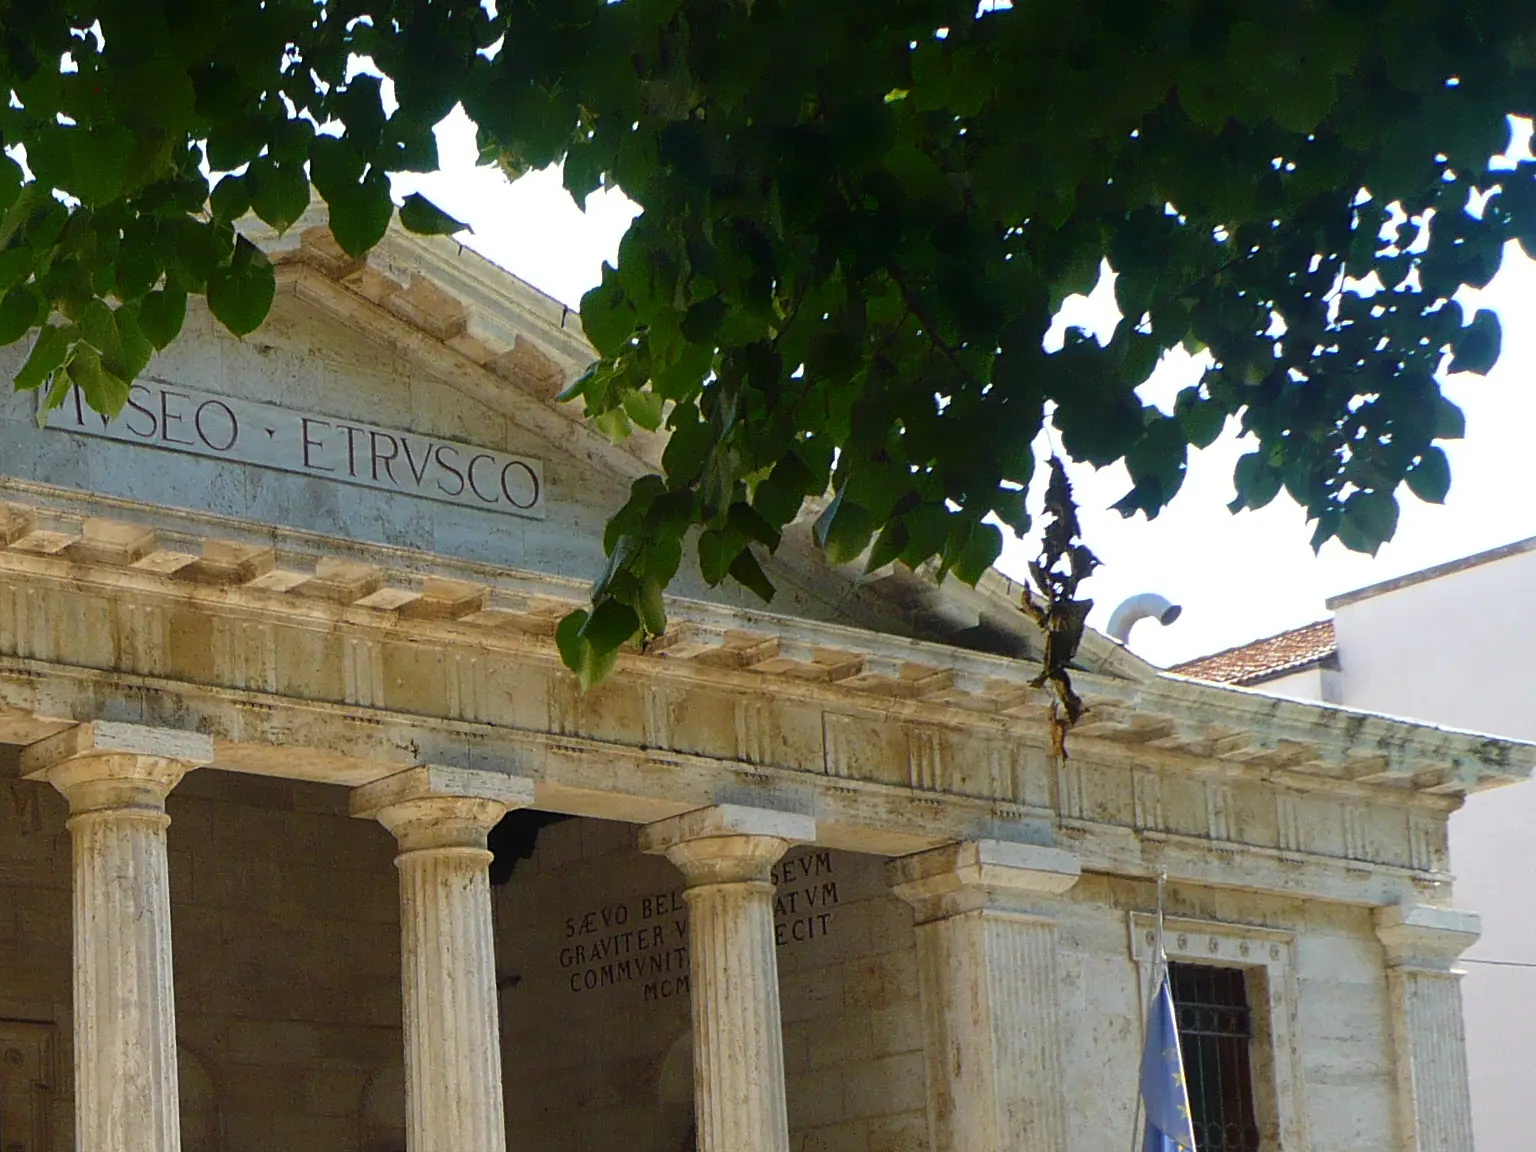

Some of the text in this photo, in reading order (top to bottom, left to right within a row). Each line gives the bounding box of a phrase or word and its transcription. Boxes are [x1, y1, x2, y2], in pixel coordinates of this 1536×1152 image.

[42, 370, 541, 510] SEO ETRVSCO
[642, 891, 683, 919] BEL
[770, 851, 833, 886] SEVM
[559, 925, 664, 968] GRAVITER
[772, 882, 839, 918] ATVM
[570, 913, 831, 992] COMMVNIT ECIT
[644, 976, 690, 1000] MCM
